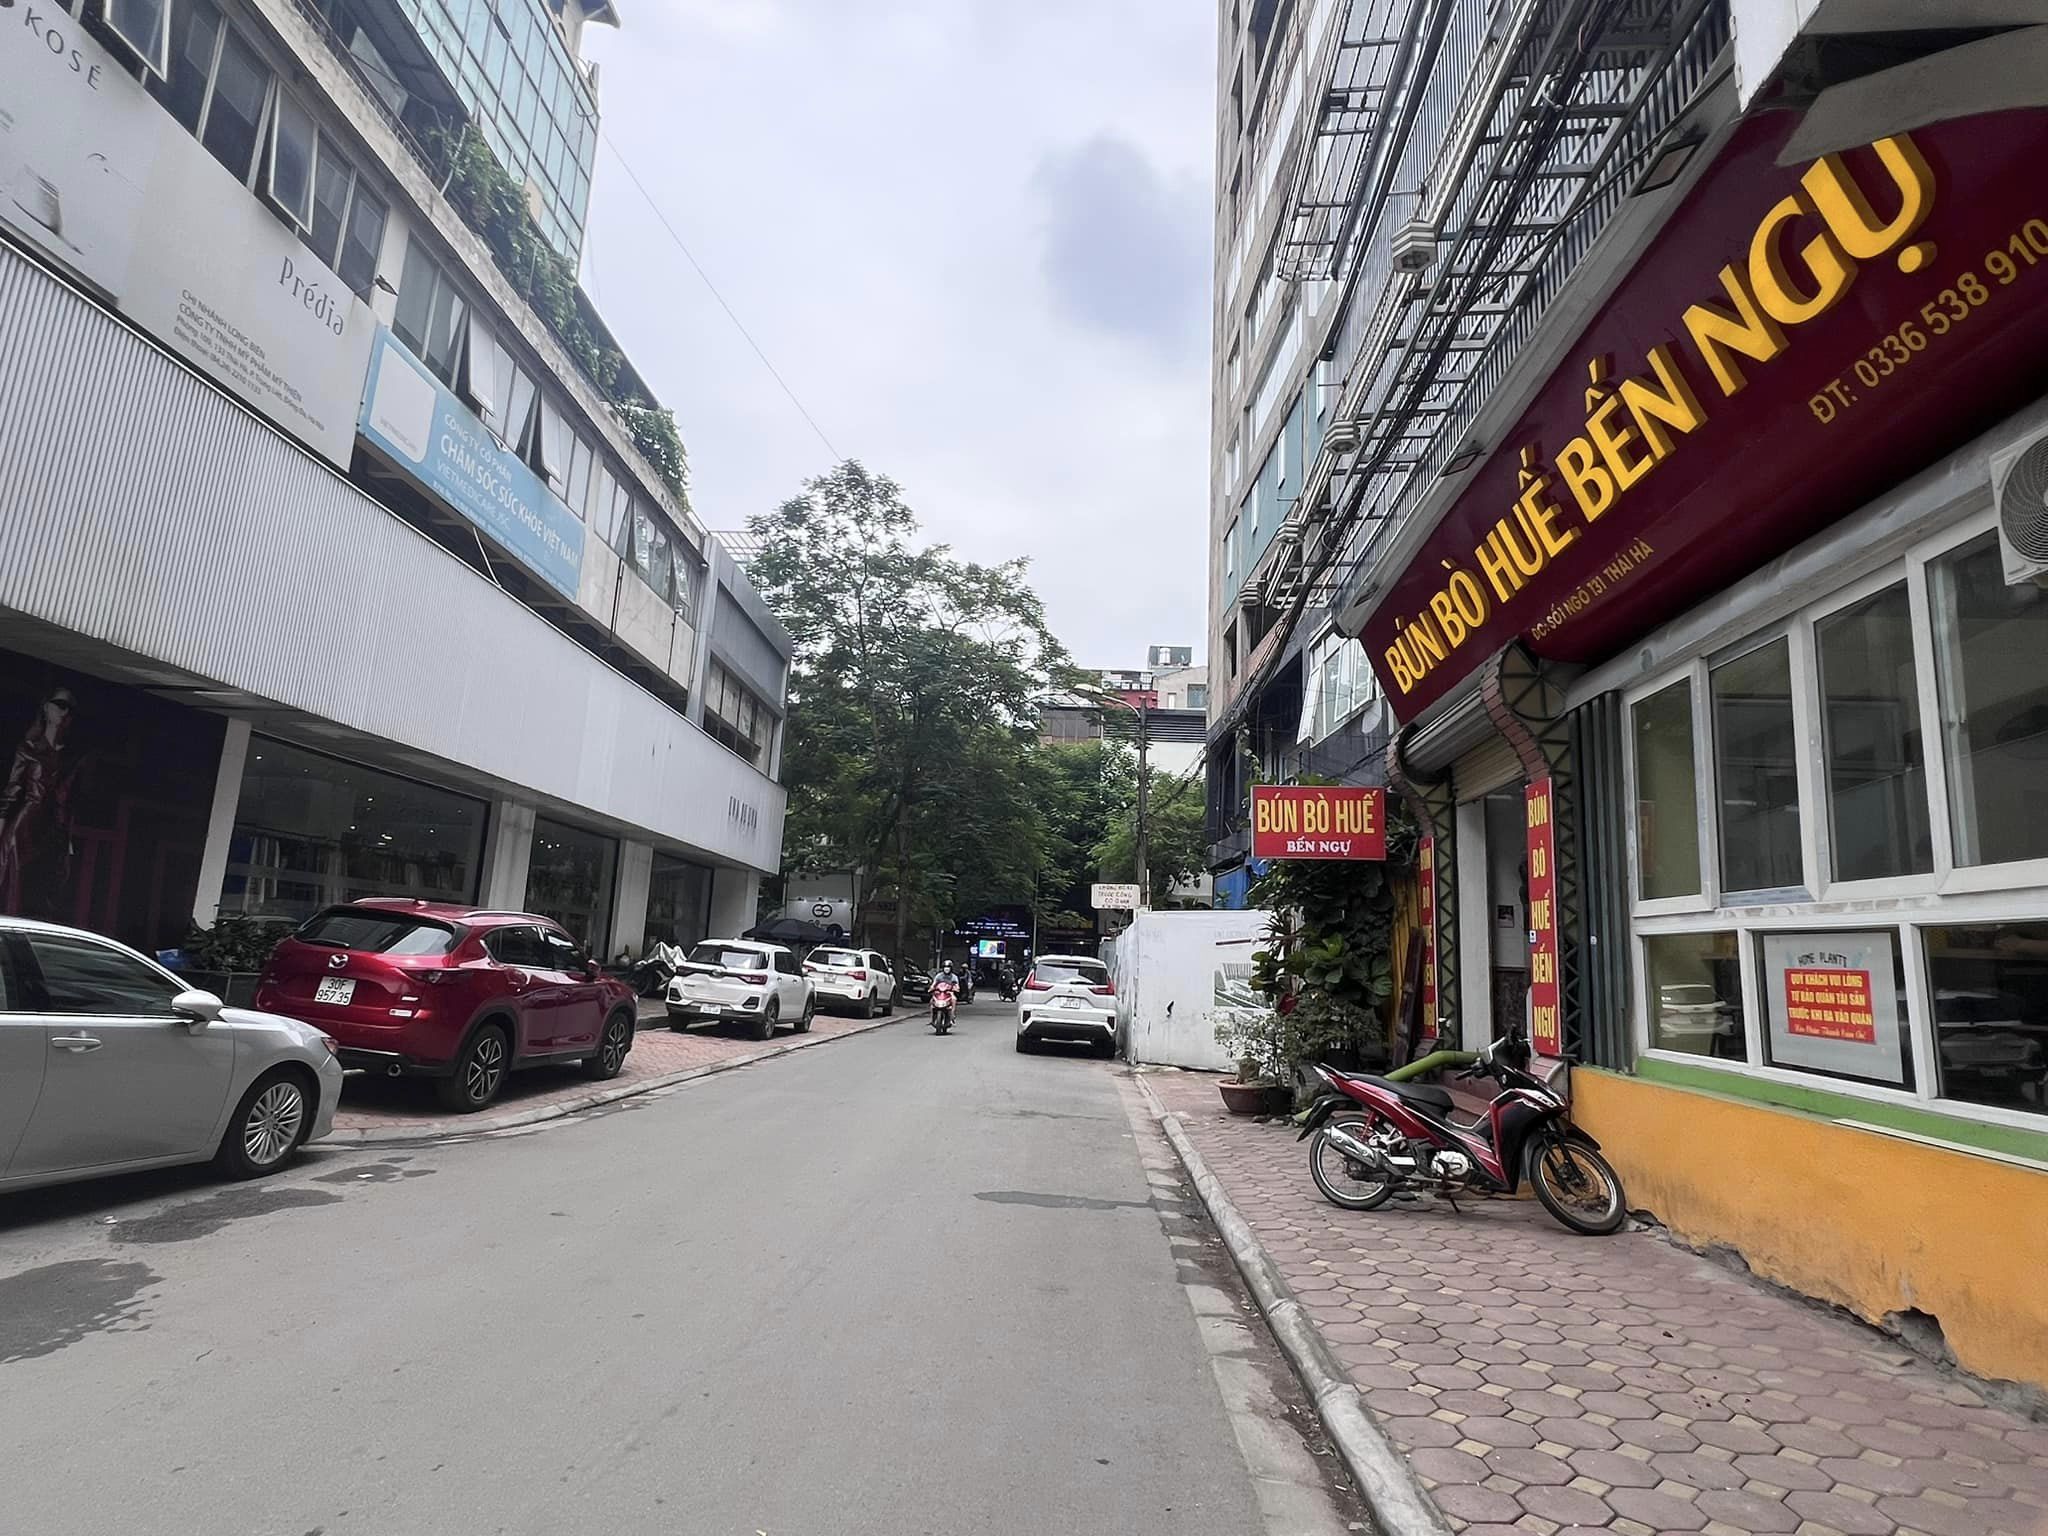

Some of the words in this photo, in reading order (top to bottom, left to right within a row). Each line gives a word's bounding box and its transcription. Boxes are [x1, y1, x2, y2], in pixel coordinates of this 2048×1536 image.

[24, 6, 102, 90] KOSÉ
[279, 256, 344, 335] Prédia
[1808, 378, 1859, 424] ĐT:
[1854, 321, 1927, 388] 0336
[1920, 271, 1989, 334] 538
[1985, 219, 2048, 284] 910
[475, 465, 498, 497] SÓC
[498, 485, 519, 516] SỨC
[1384, 617, 1447, 695] BÚN
[1430, 559, 1487, 648] BÒ
[1475, 447, 1577, 603] HUẾ
[1555, 357, 1700, 523] BẾN
[1586, 576, 1607, 597] 131
[1603, 552, 1635, 583] THÁI
[1629, 537, 1655, 563] HÀ
[1257, 792, 1297, 833] BÚN
[1303, 792, 1329, 833] BÒ
[1336, 790, 1378, 833] HUẾ
[1528, 790, 1548, 828] BÚN
[1286, 836, 1318, 853] BẾN
[1320, 839, 1351, 856] NGỰ
[1532, 841, 1546, 879] BÒ
[1531, 889, 1551, 930] HUẾ
[328, 978, 348, 990] 30F
[1532, 943, 1553, 984] BẾN
[1533, 1004, 1556, 1046] NGỰ
